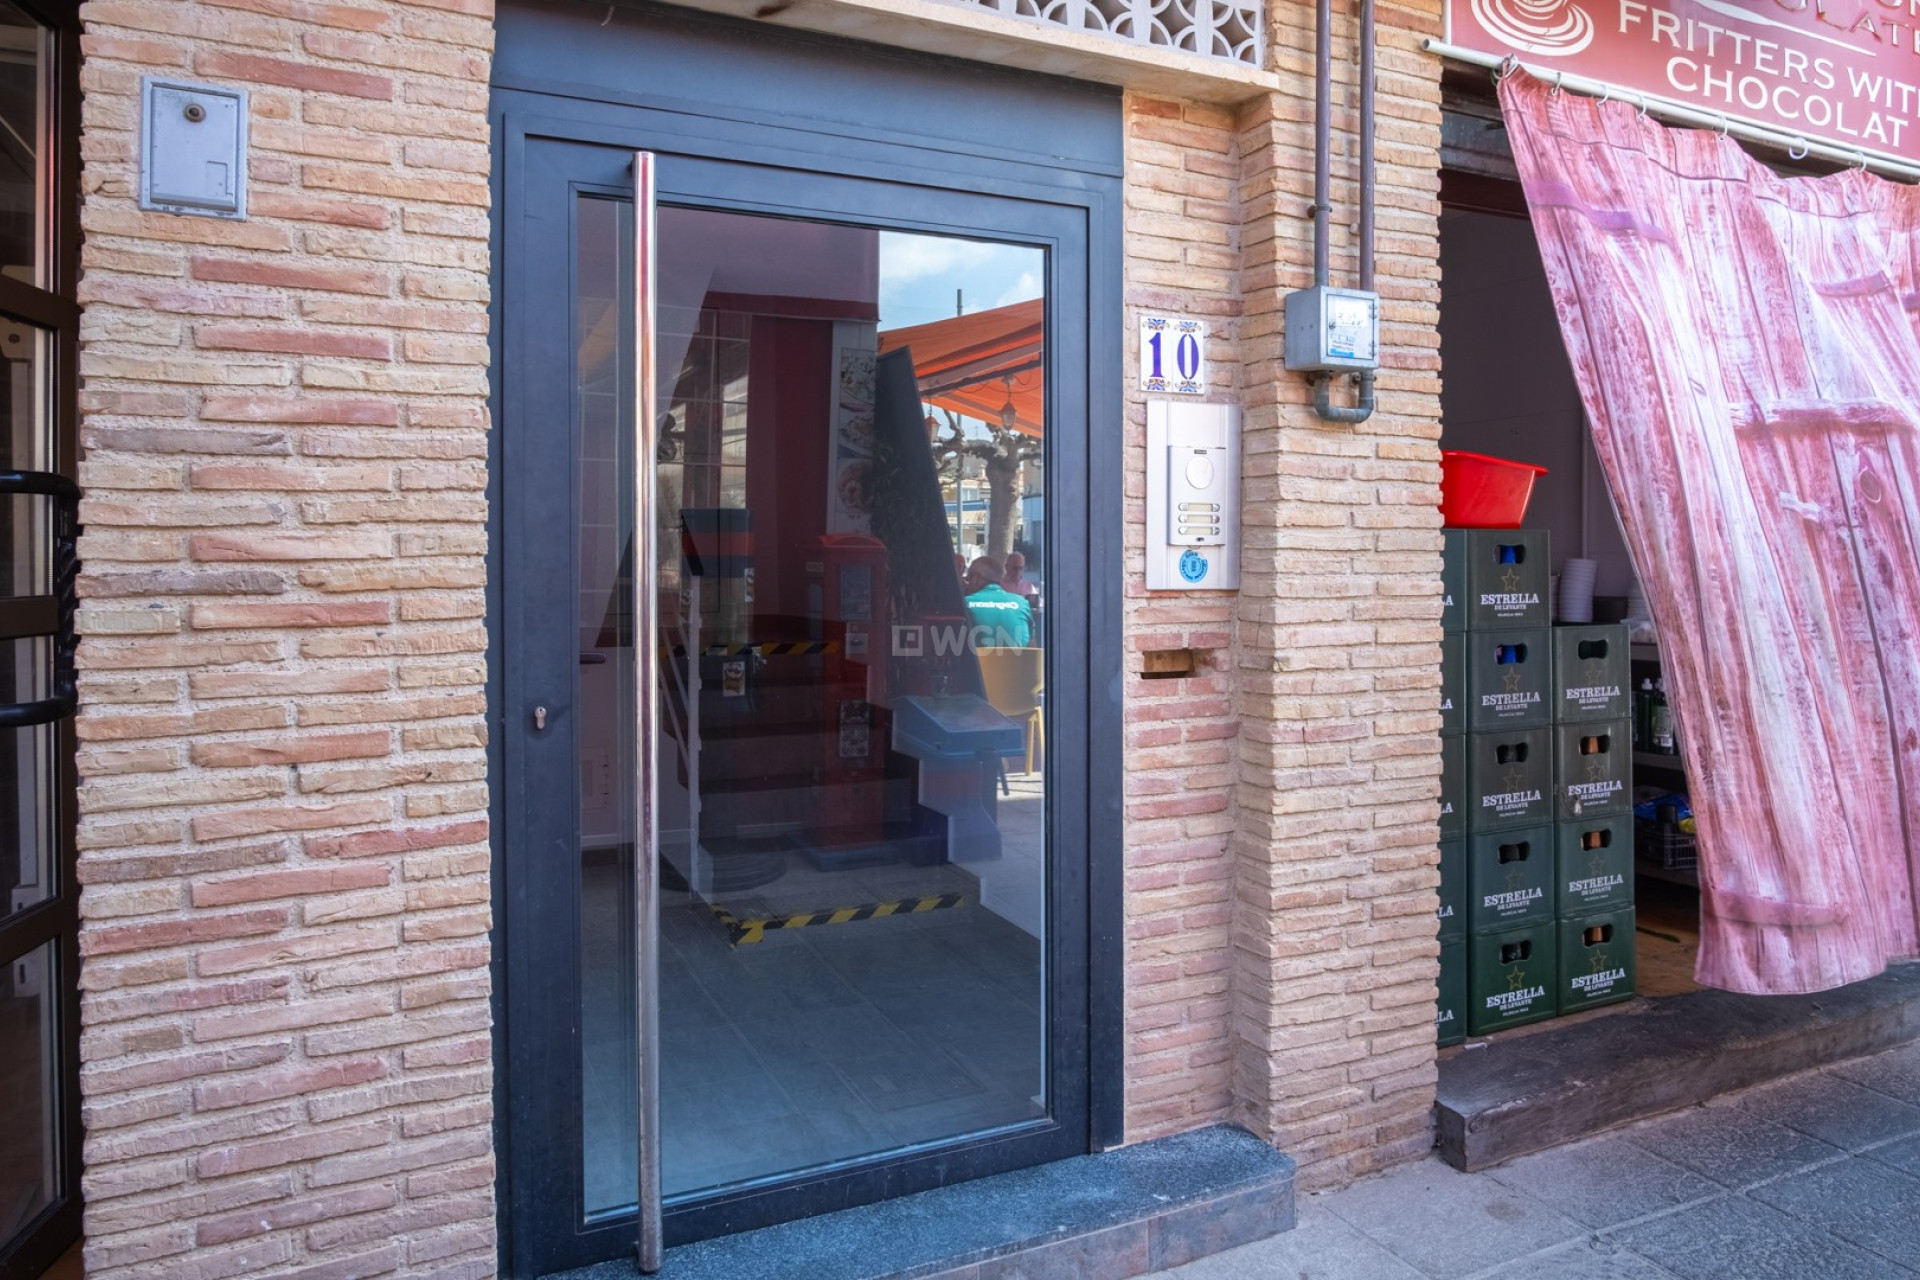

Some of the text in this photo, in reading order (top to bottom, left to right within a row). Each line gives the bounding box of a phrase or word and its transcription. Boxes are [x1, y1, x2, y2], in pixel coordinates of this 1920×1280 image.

[1619, 0, 1920, 118] FRITTERS WIT
[1666, 56, 1908, 148] CHOCOLAT
[1149, 332, 1199, 380] 10
[1480, 593, 1539, 605] ESTRELLA
[1482, 691, 1541, 706] ESTRELLA
[1566, 685, 1621, 699] ESTRELLA
[1568, 780, 1623, 796] ESTRELLA
[1482, 789, 1541, 807] ESTRELLA
[1569, 873, 1624, 892] ESTRELLA
[1483, 887, 1543, 907] ESTRELLA
[1571, 967, 1626, 989] ESTRELLA
[1485, 985, 1545, 1008] ESTRELLA
